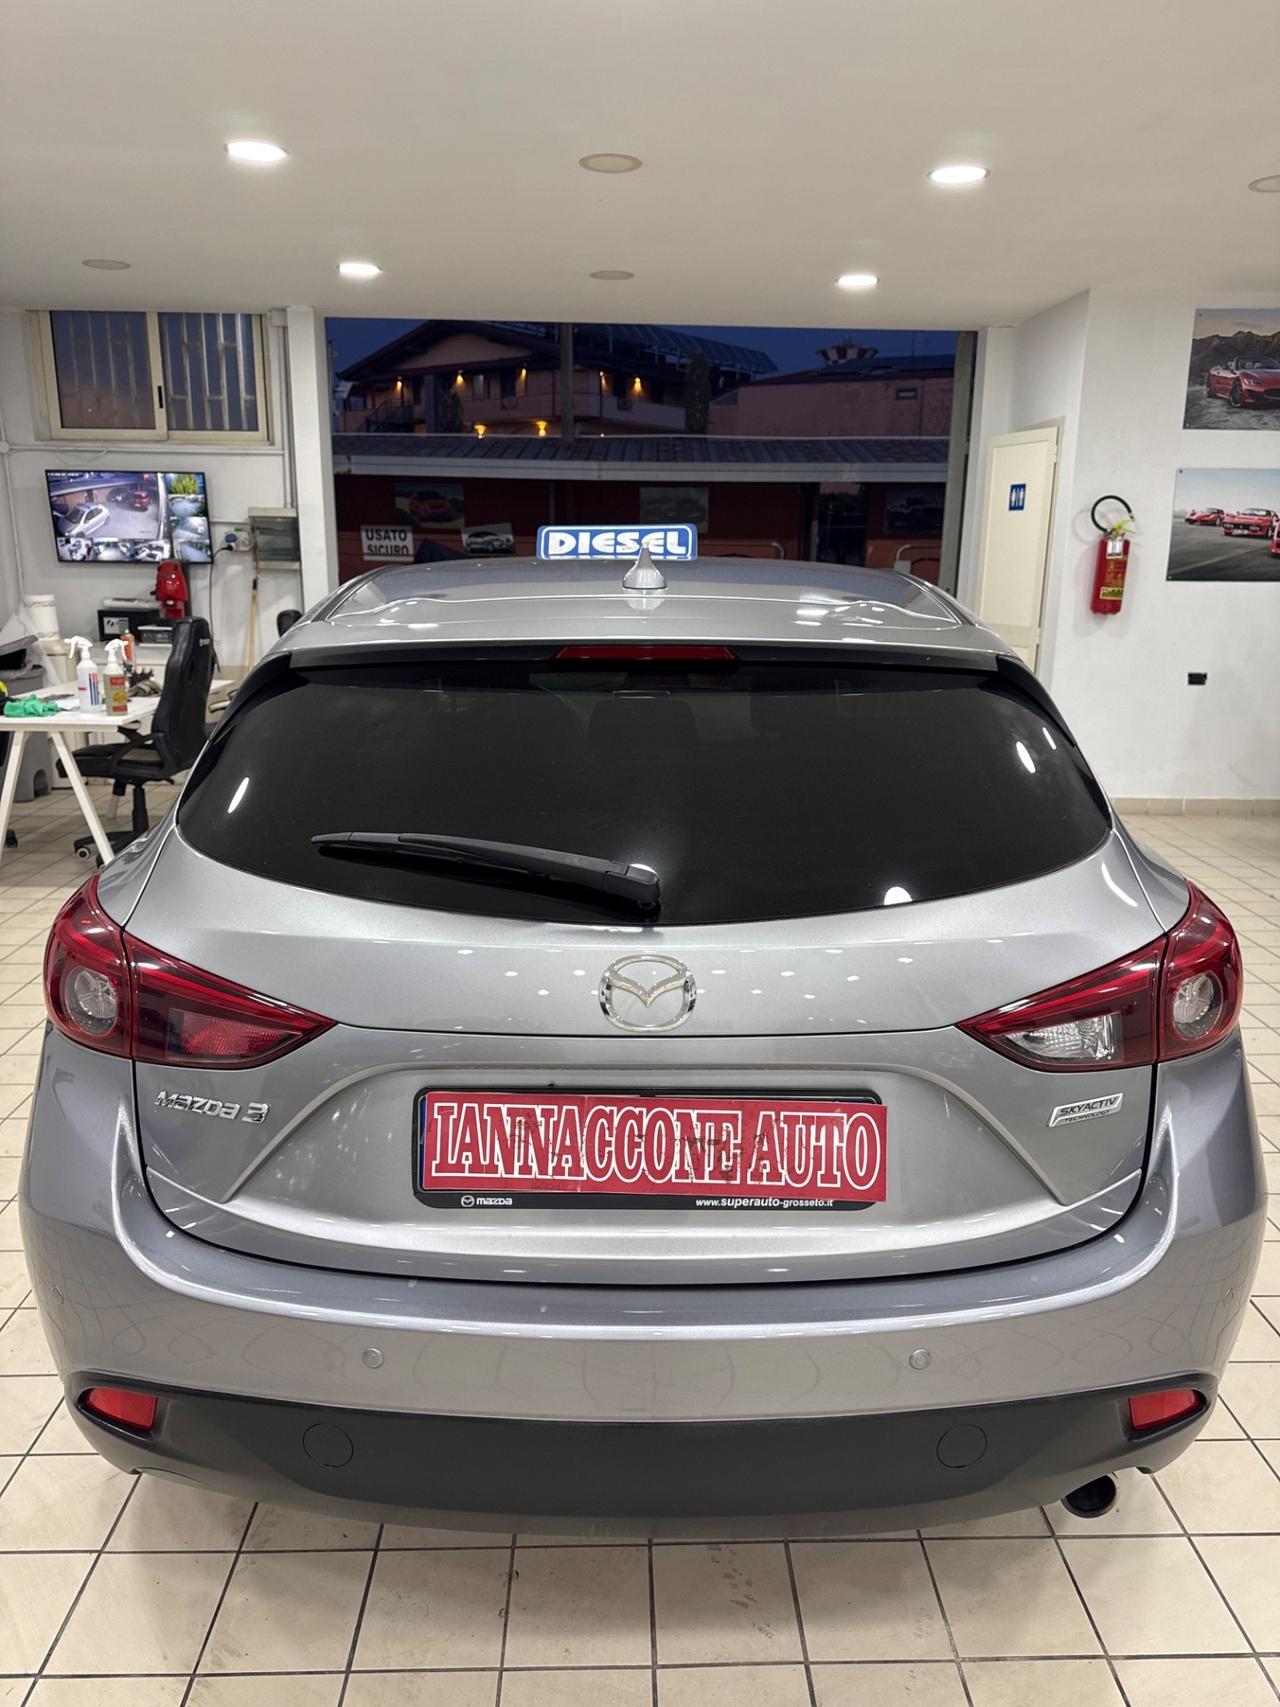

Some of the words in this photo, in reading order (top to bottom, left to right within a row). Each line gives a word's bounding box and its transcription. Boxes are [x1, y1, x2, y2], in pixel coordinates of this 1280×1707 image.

[365, 528, 407, 541] USATO
[548, 531, 686, 555] DIESEL
[367, 544, 409, 556] SICURO
[241, 1101, 270, 1124] 3
[1059, 1097, 1117, 1116] SKYACTIV
[1064, 1109, 1111, 1122] TECHNOLOGY
[432, 1102, 742, 1185] IANNACCONE
[747, 1110, 881, 1190] AUTO
[476, 1196, 513, 1206] mazda
[695, 1196, 834, 1209] www.superauto-grosseto.it
